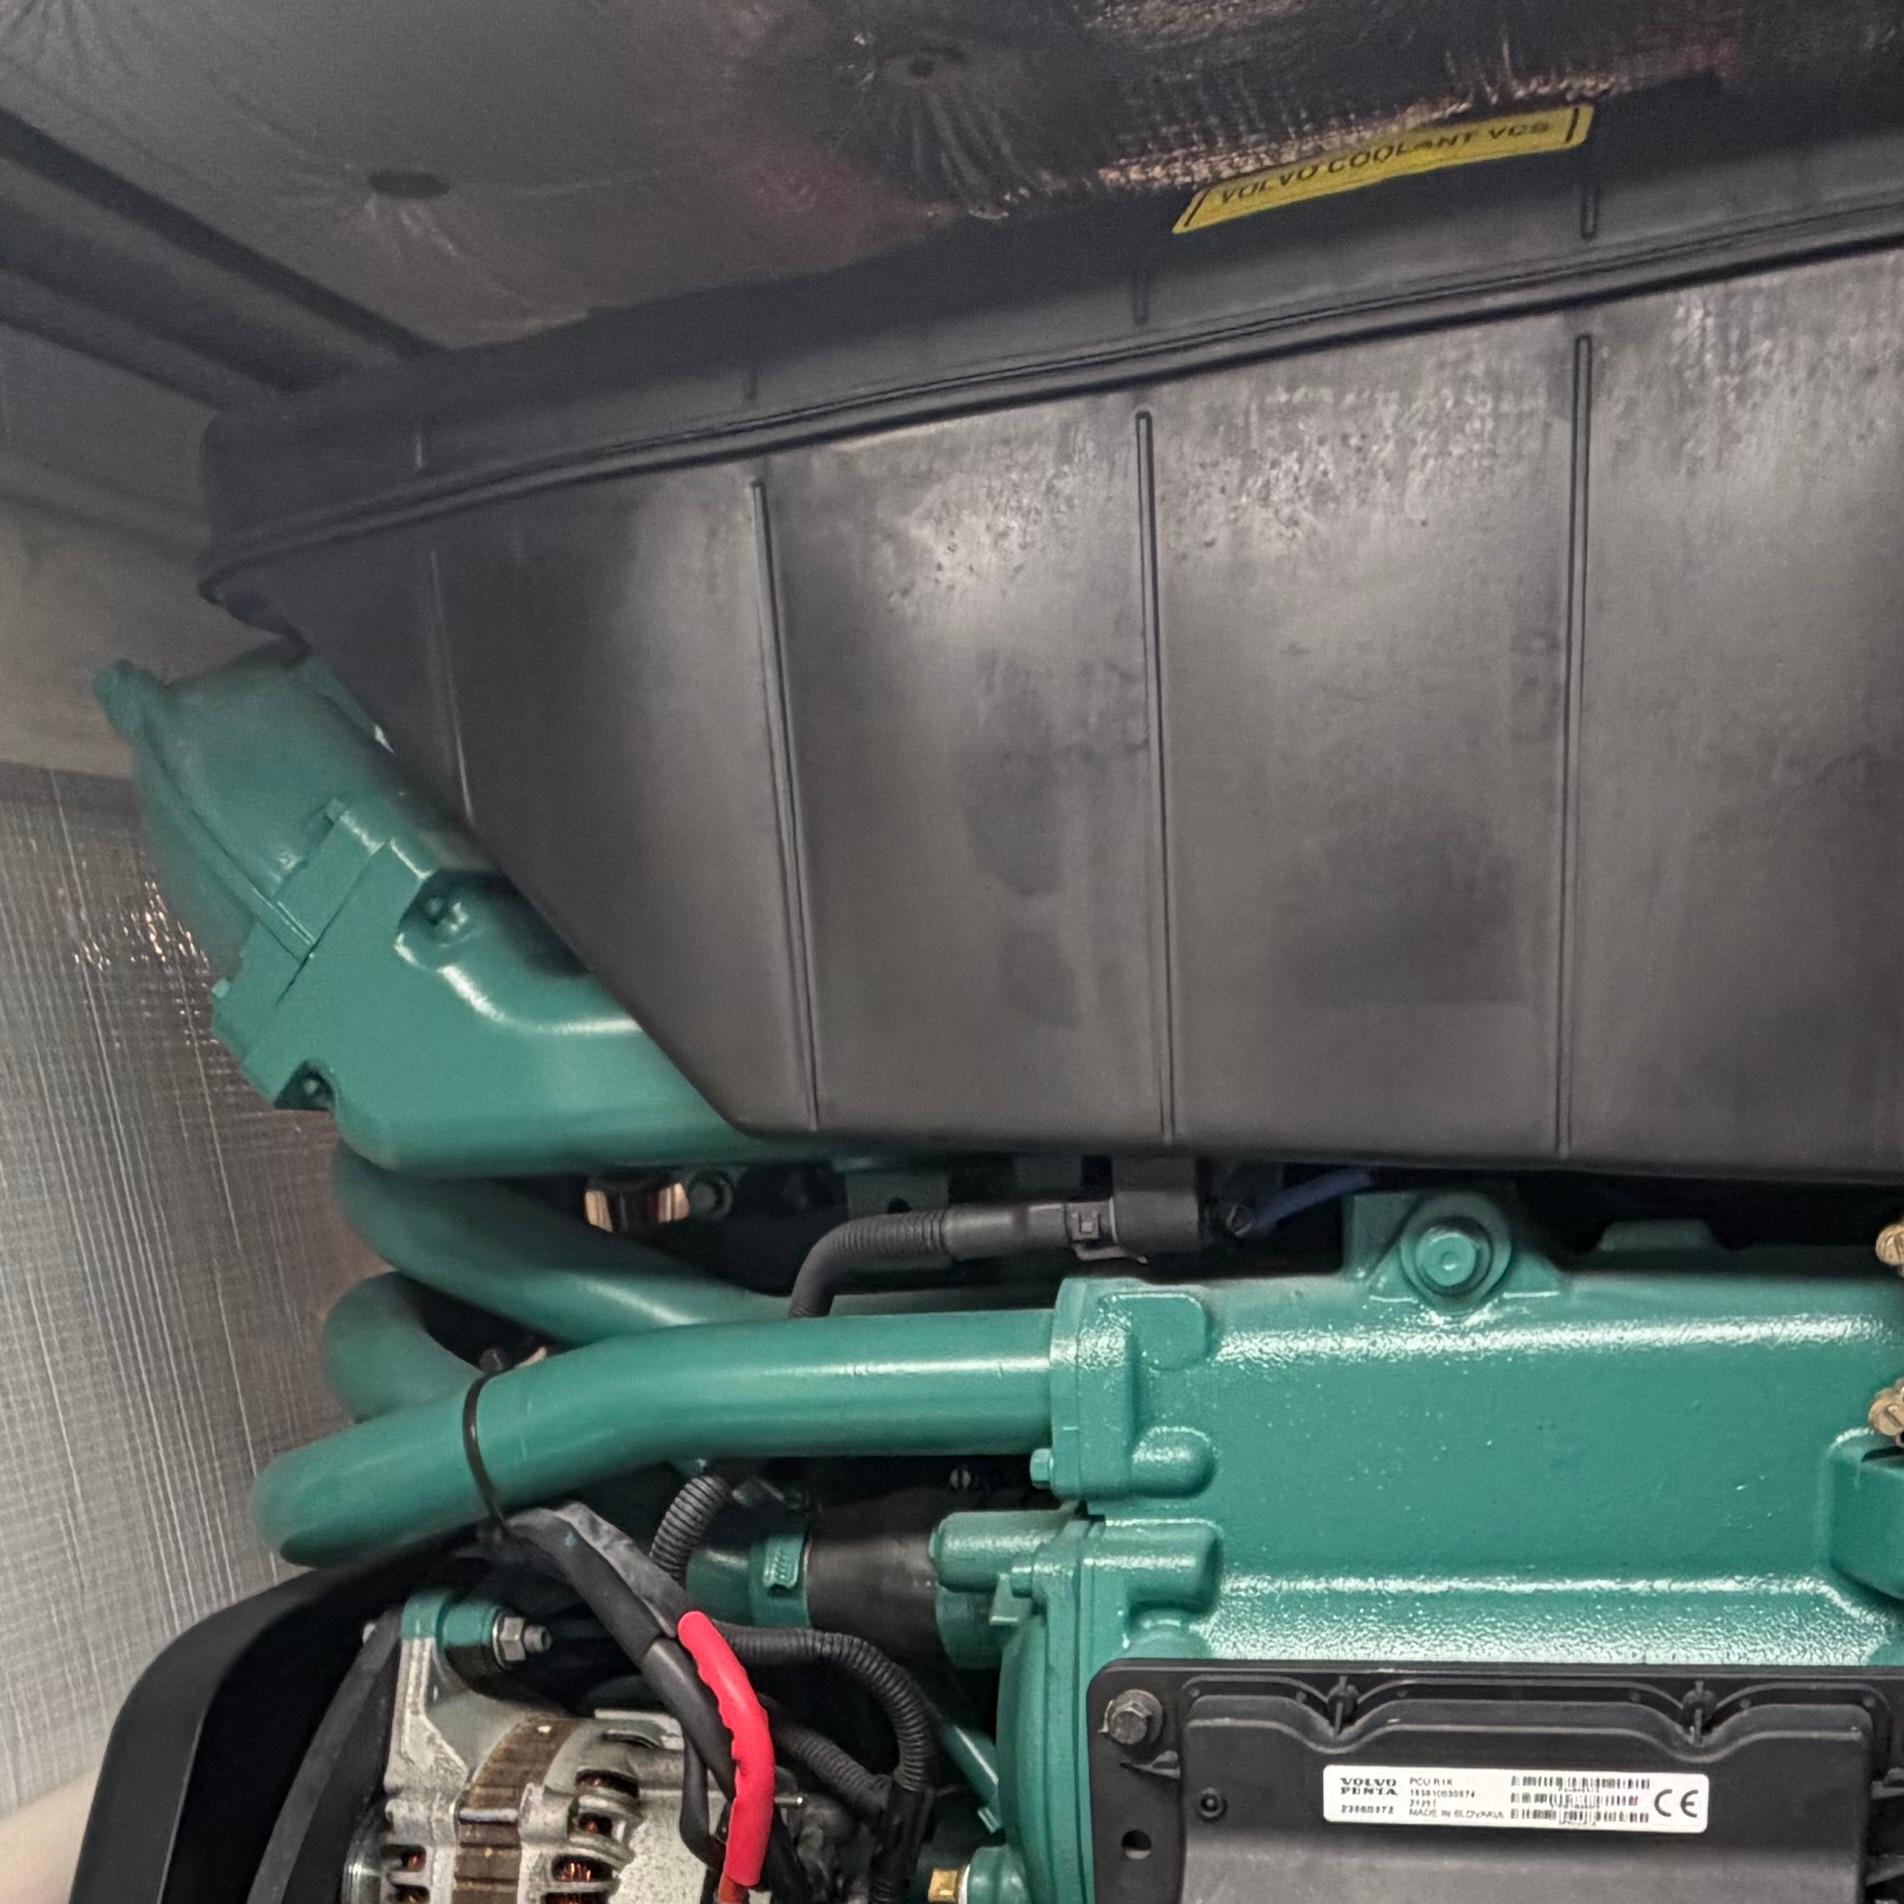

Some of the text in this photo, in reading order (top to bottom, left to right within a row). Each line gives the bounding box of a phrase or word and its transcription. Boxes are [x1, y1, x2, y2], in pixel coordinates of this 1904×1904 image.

[1221, 166, 1319, 206] VOLVO
[1327, 132, 1476, 174] COOLANT
[1339, 1777, 1397, 1787] VOLVO
[1340, 1787, 1398, 1796] PENTA
